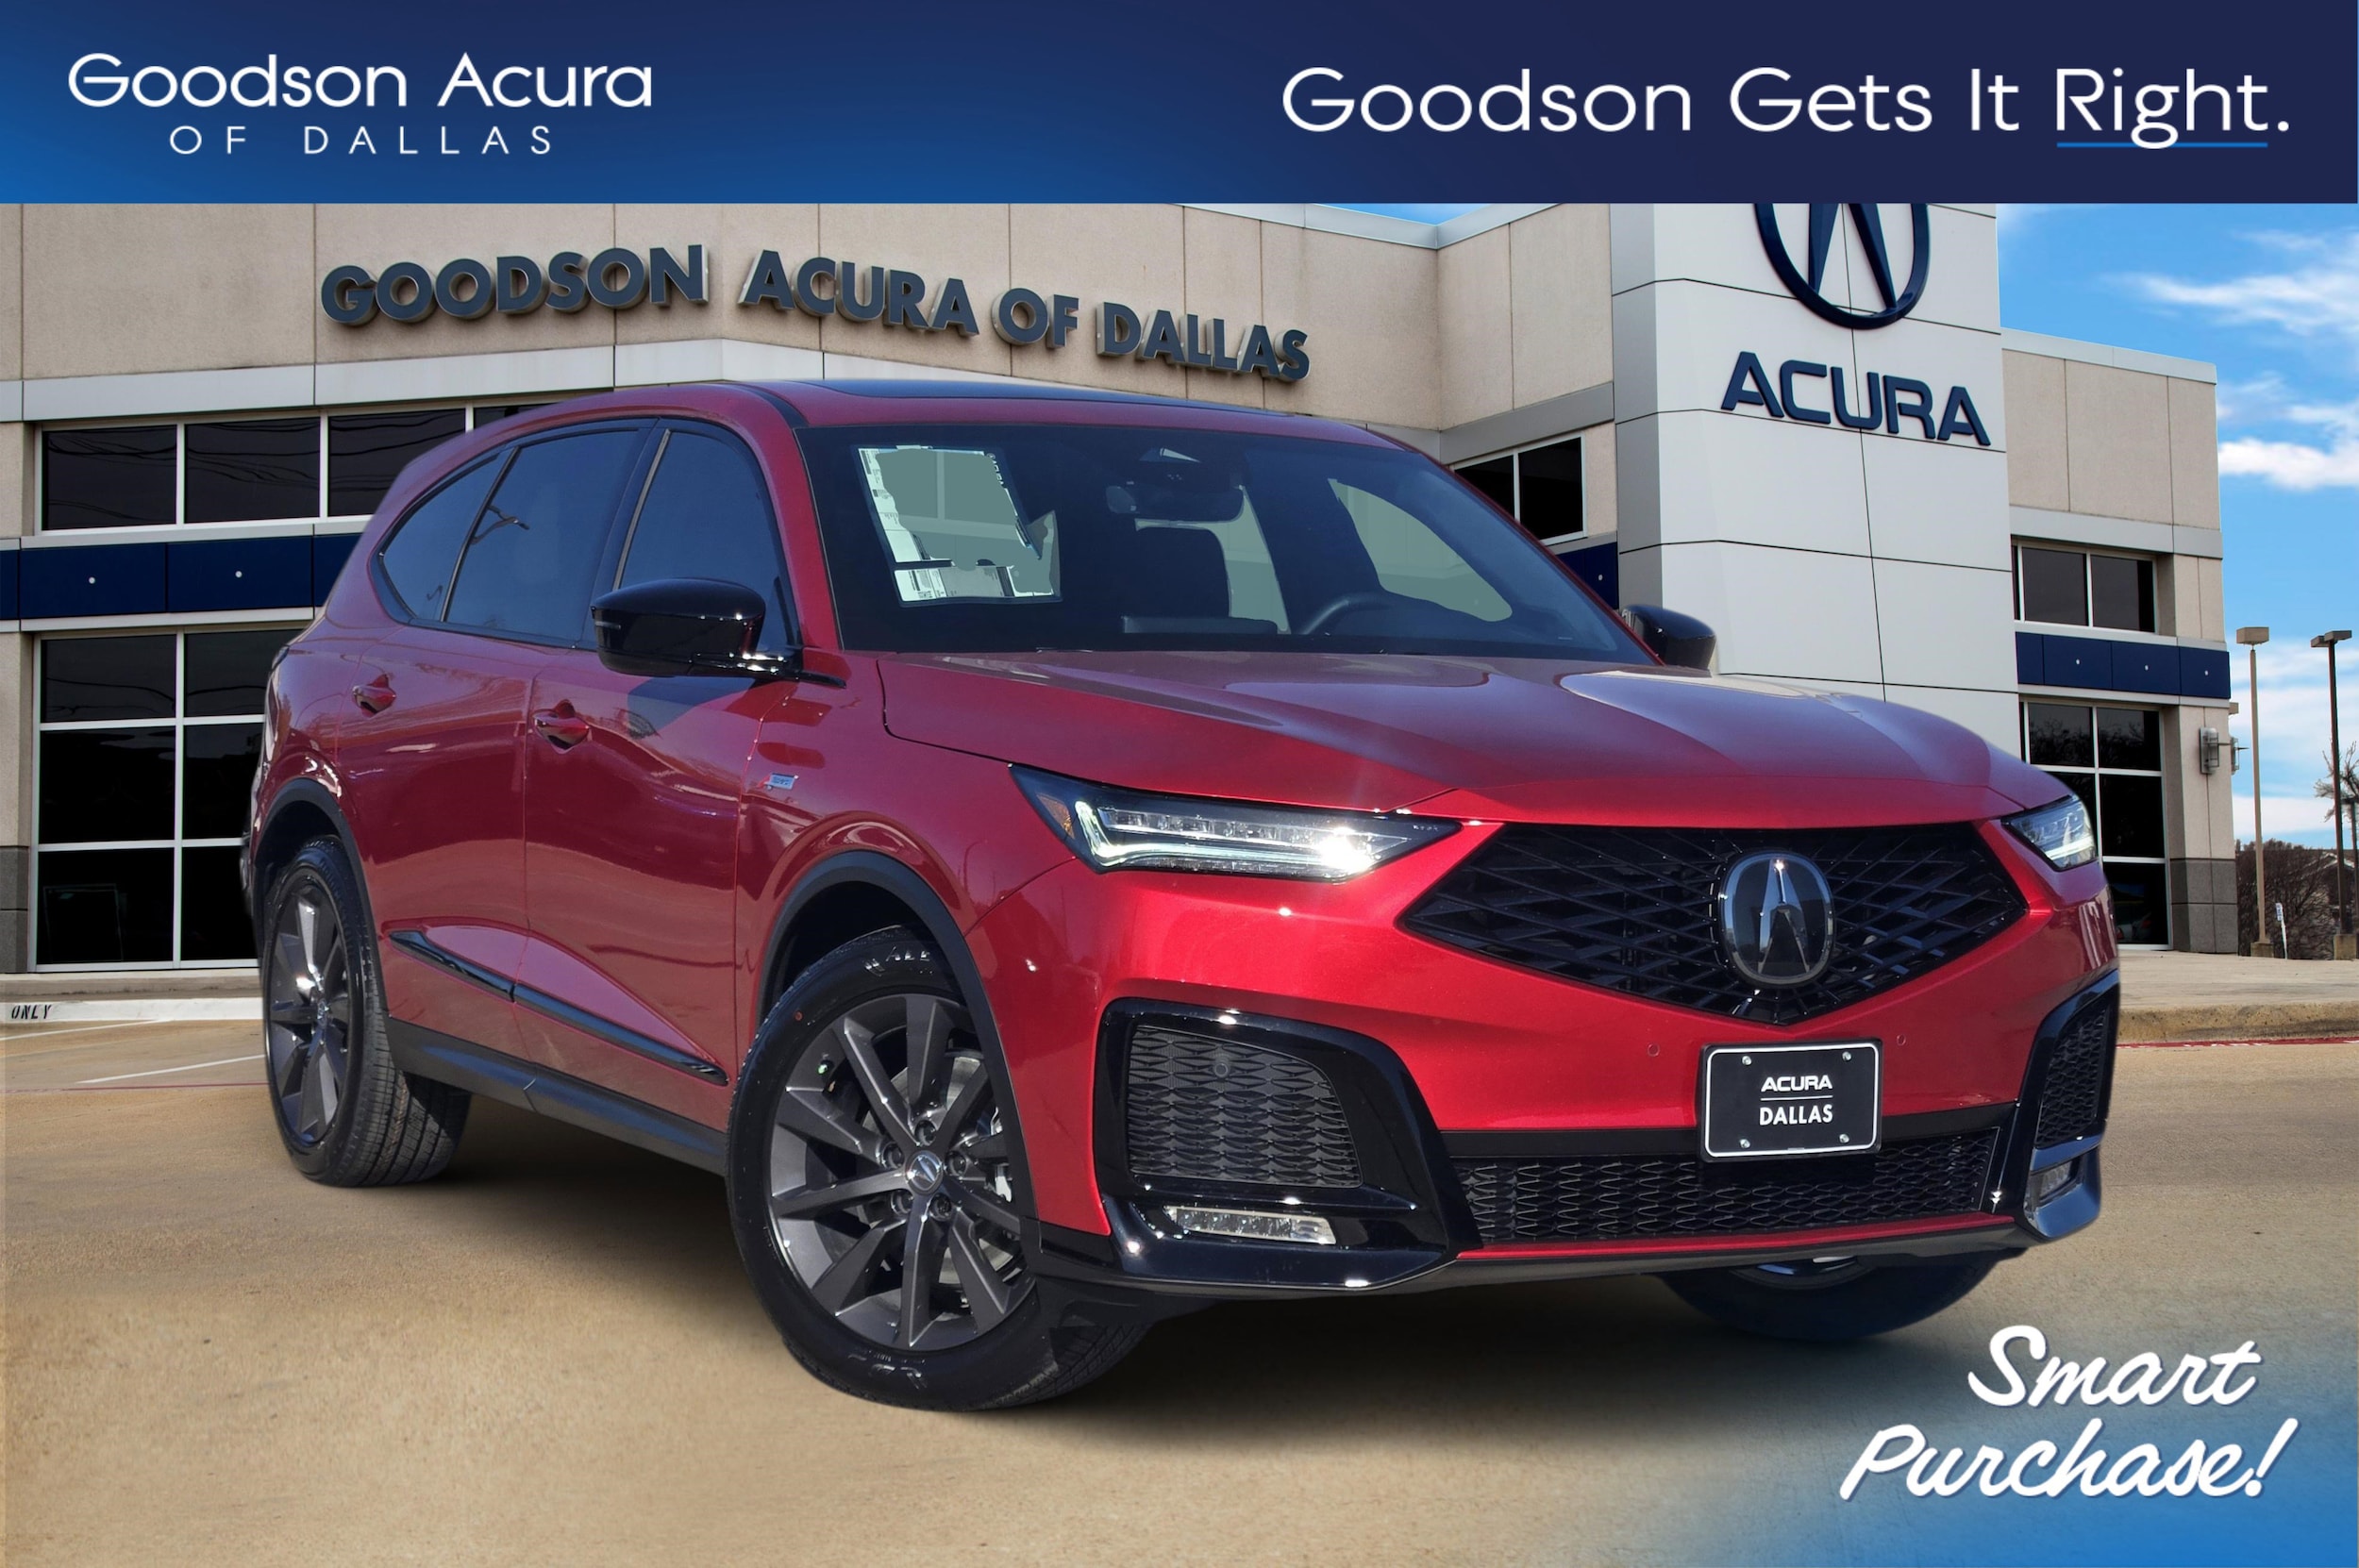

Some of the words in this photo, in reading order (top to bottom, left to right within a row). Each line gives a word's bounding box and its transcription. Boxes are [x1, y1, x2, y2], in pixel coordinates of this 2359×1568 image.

[321, 243, 710, 327] GOODSON
[738, 249, 980, 338] ACURA
[992, 287, 1079, 349] OF
[1096, 301, 1310, 382] DALLAS
[1720, 351, 1991, 447] ACURA
[10, 1003, 52, 1020] ONLY
[1761, 1075, 1833, 1093] ACURA
[1759, 1104, 1833, 1126] DALLAS
